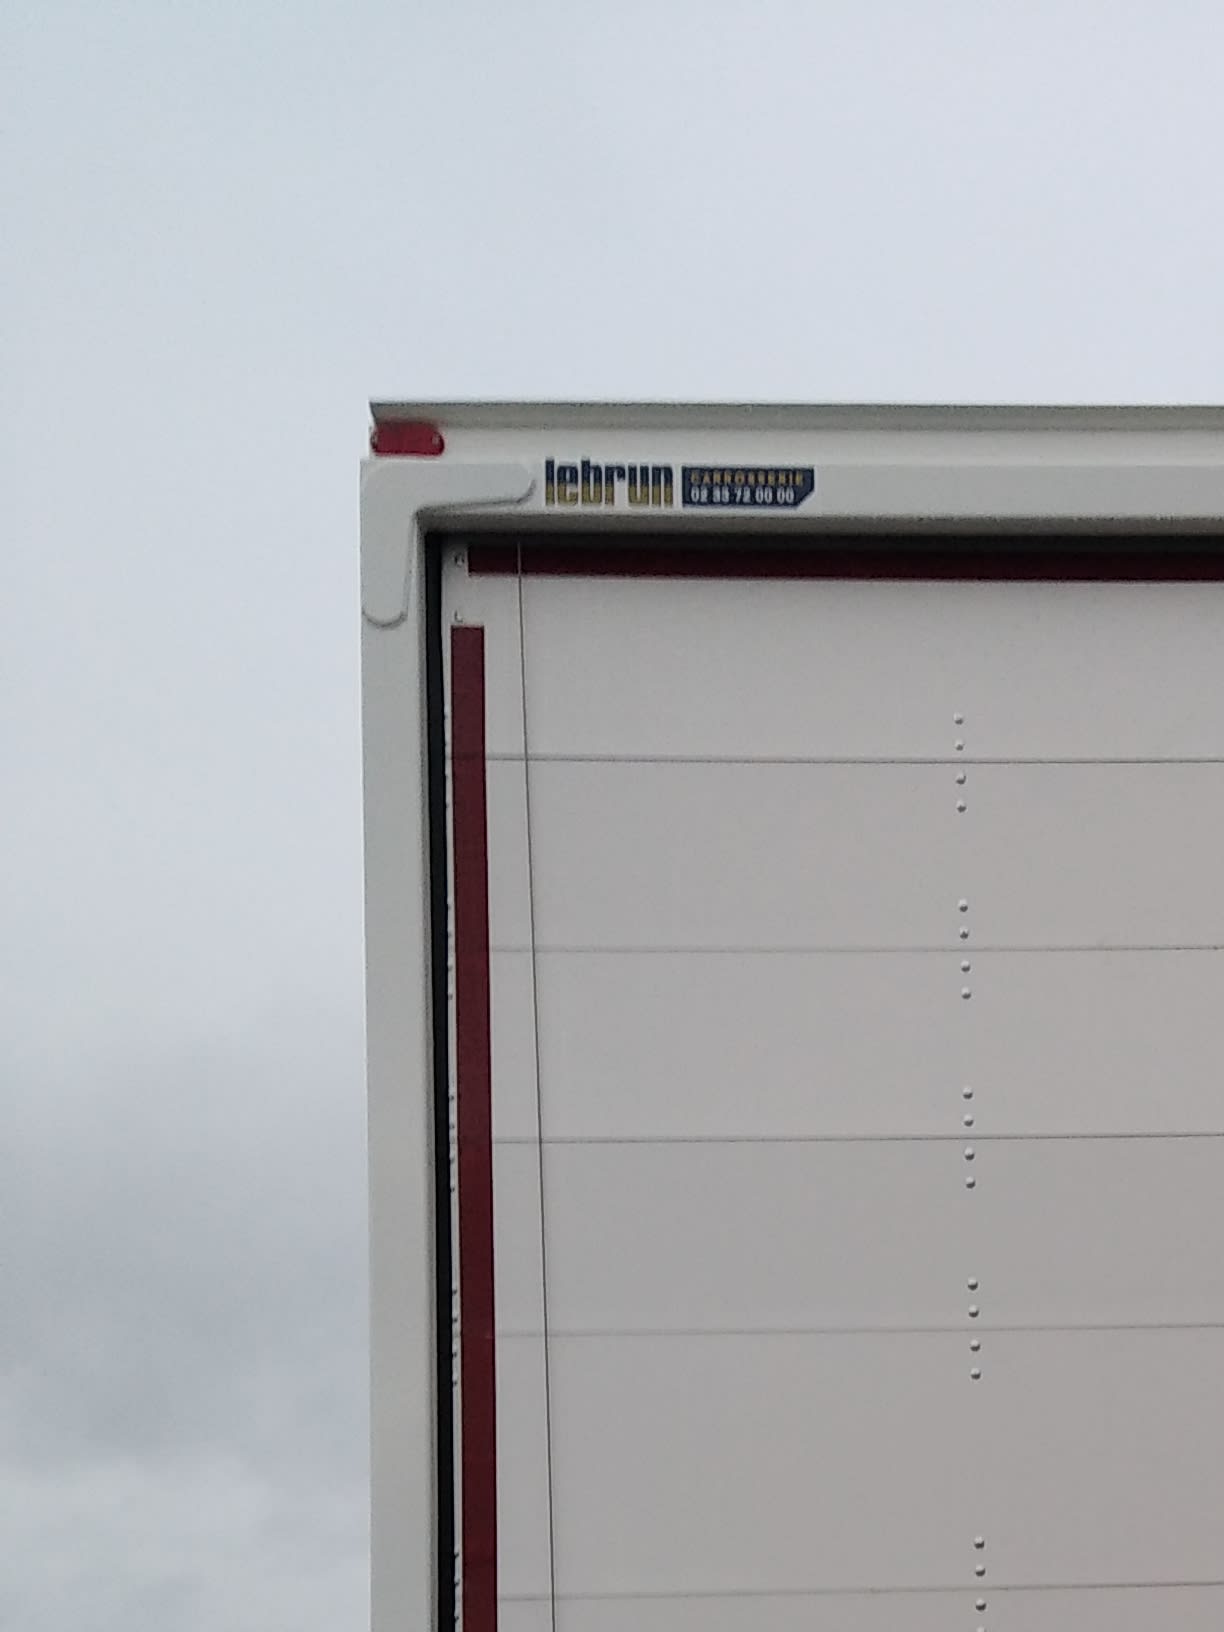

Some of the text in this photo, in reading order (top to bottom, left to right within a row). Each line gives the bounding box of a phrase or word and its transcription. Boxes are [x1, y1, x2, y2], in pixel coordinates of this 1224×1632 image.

[545, 459, 674, 507] lebrun
[755, 485, 773, 503] 00
[776, 485, 795, 503] 00
